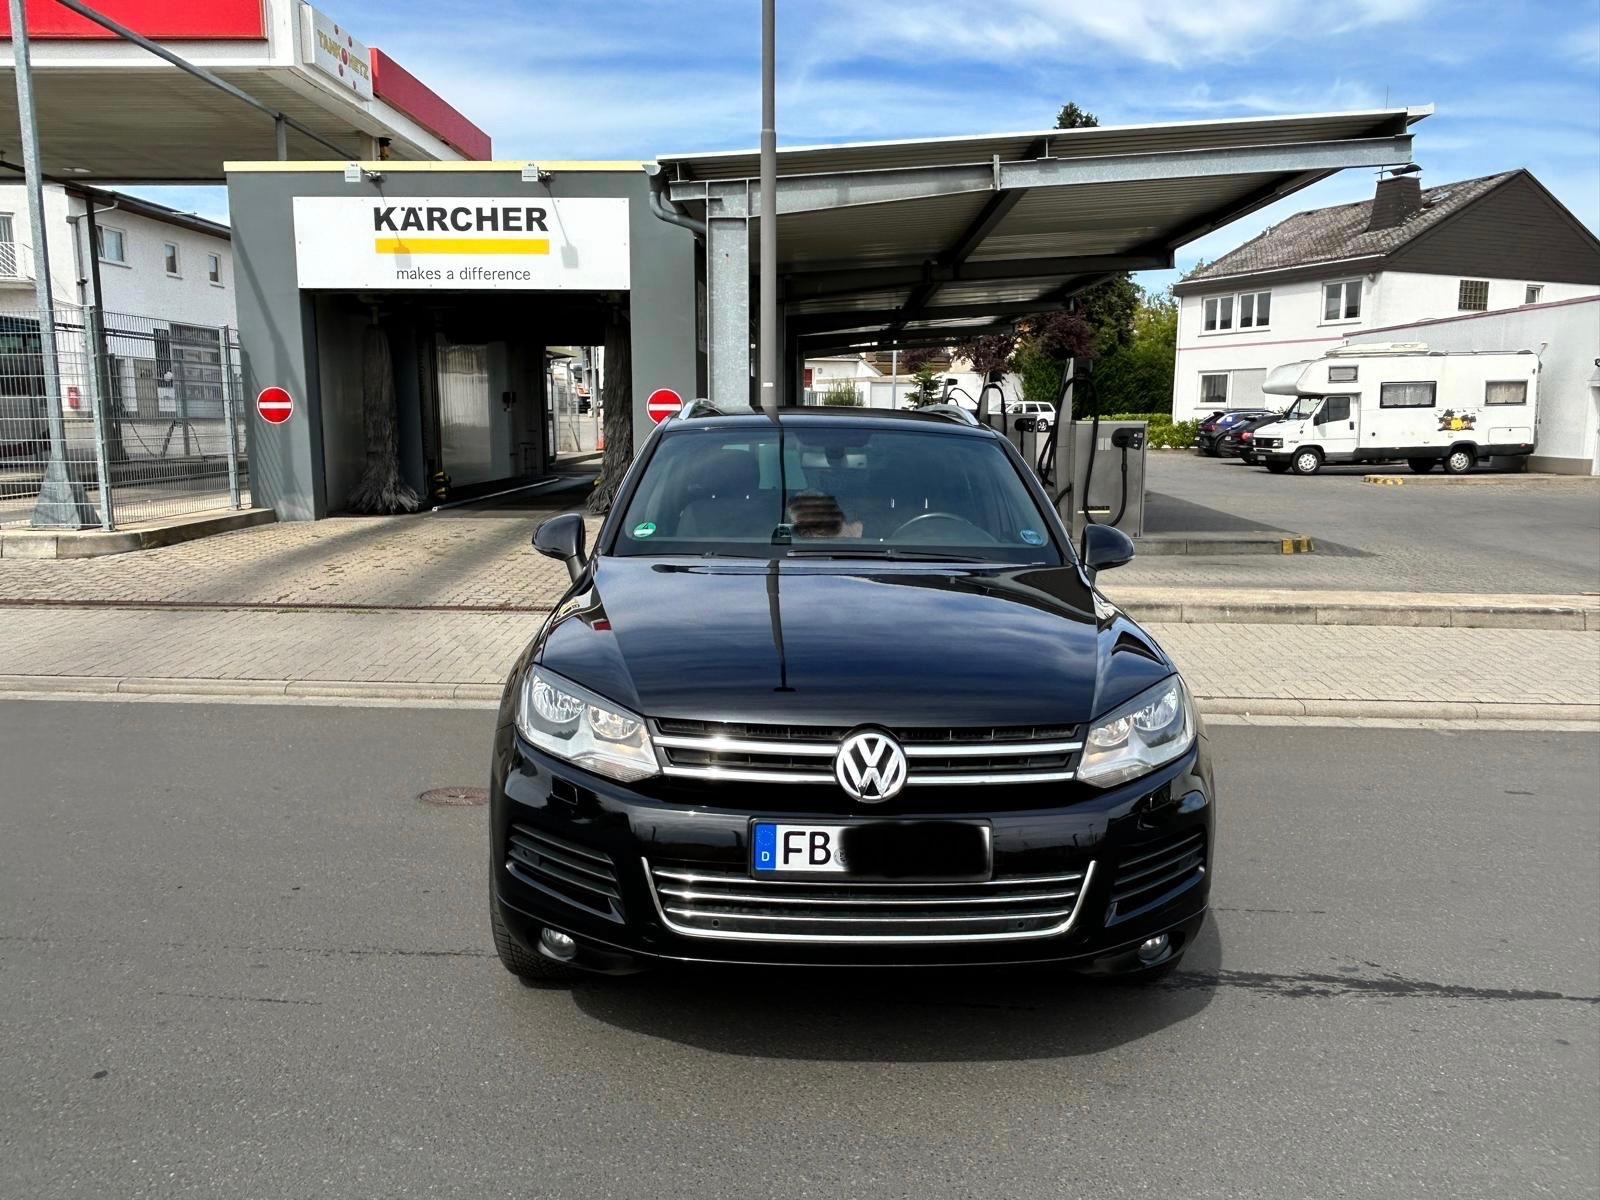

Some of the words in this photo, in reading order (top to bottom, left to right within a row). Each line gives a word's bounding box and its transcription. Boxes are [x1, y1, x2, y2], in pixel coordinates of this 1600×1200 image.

[373, 206, 549, 232] KÄRCHER
[396, 266, 442, 280] makes
[446, 269, 455, 280] a
[459, 266, 531, 281] difference
[761, 851, 770, 861] D
[783, 830, 832, 866] FB
